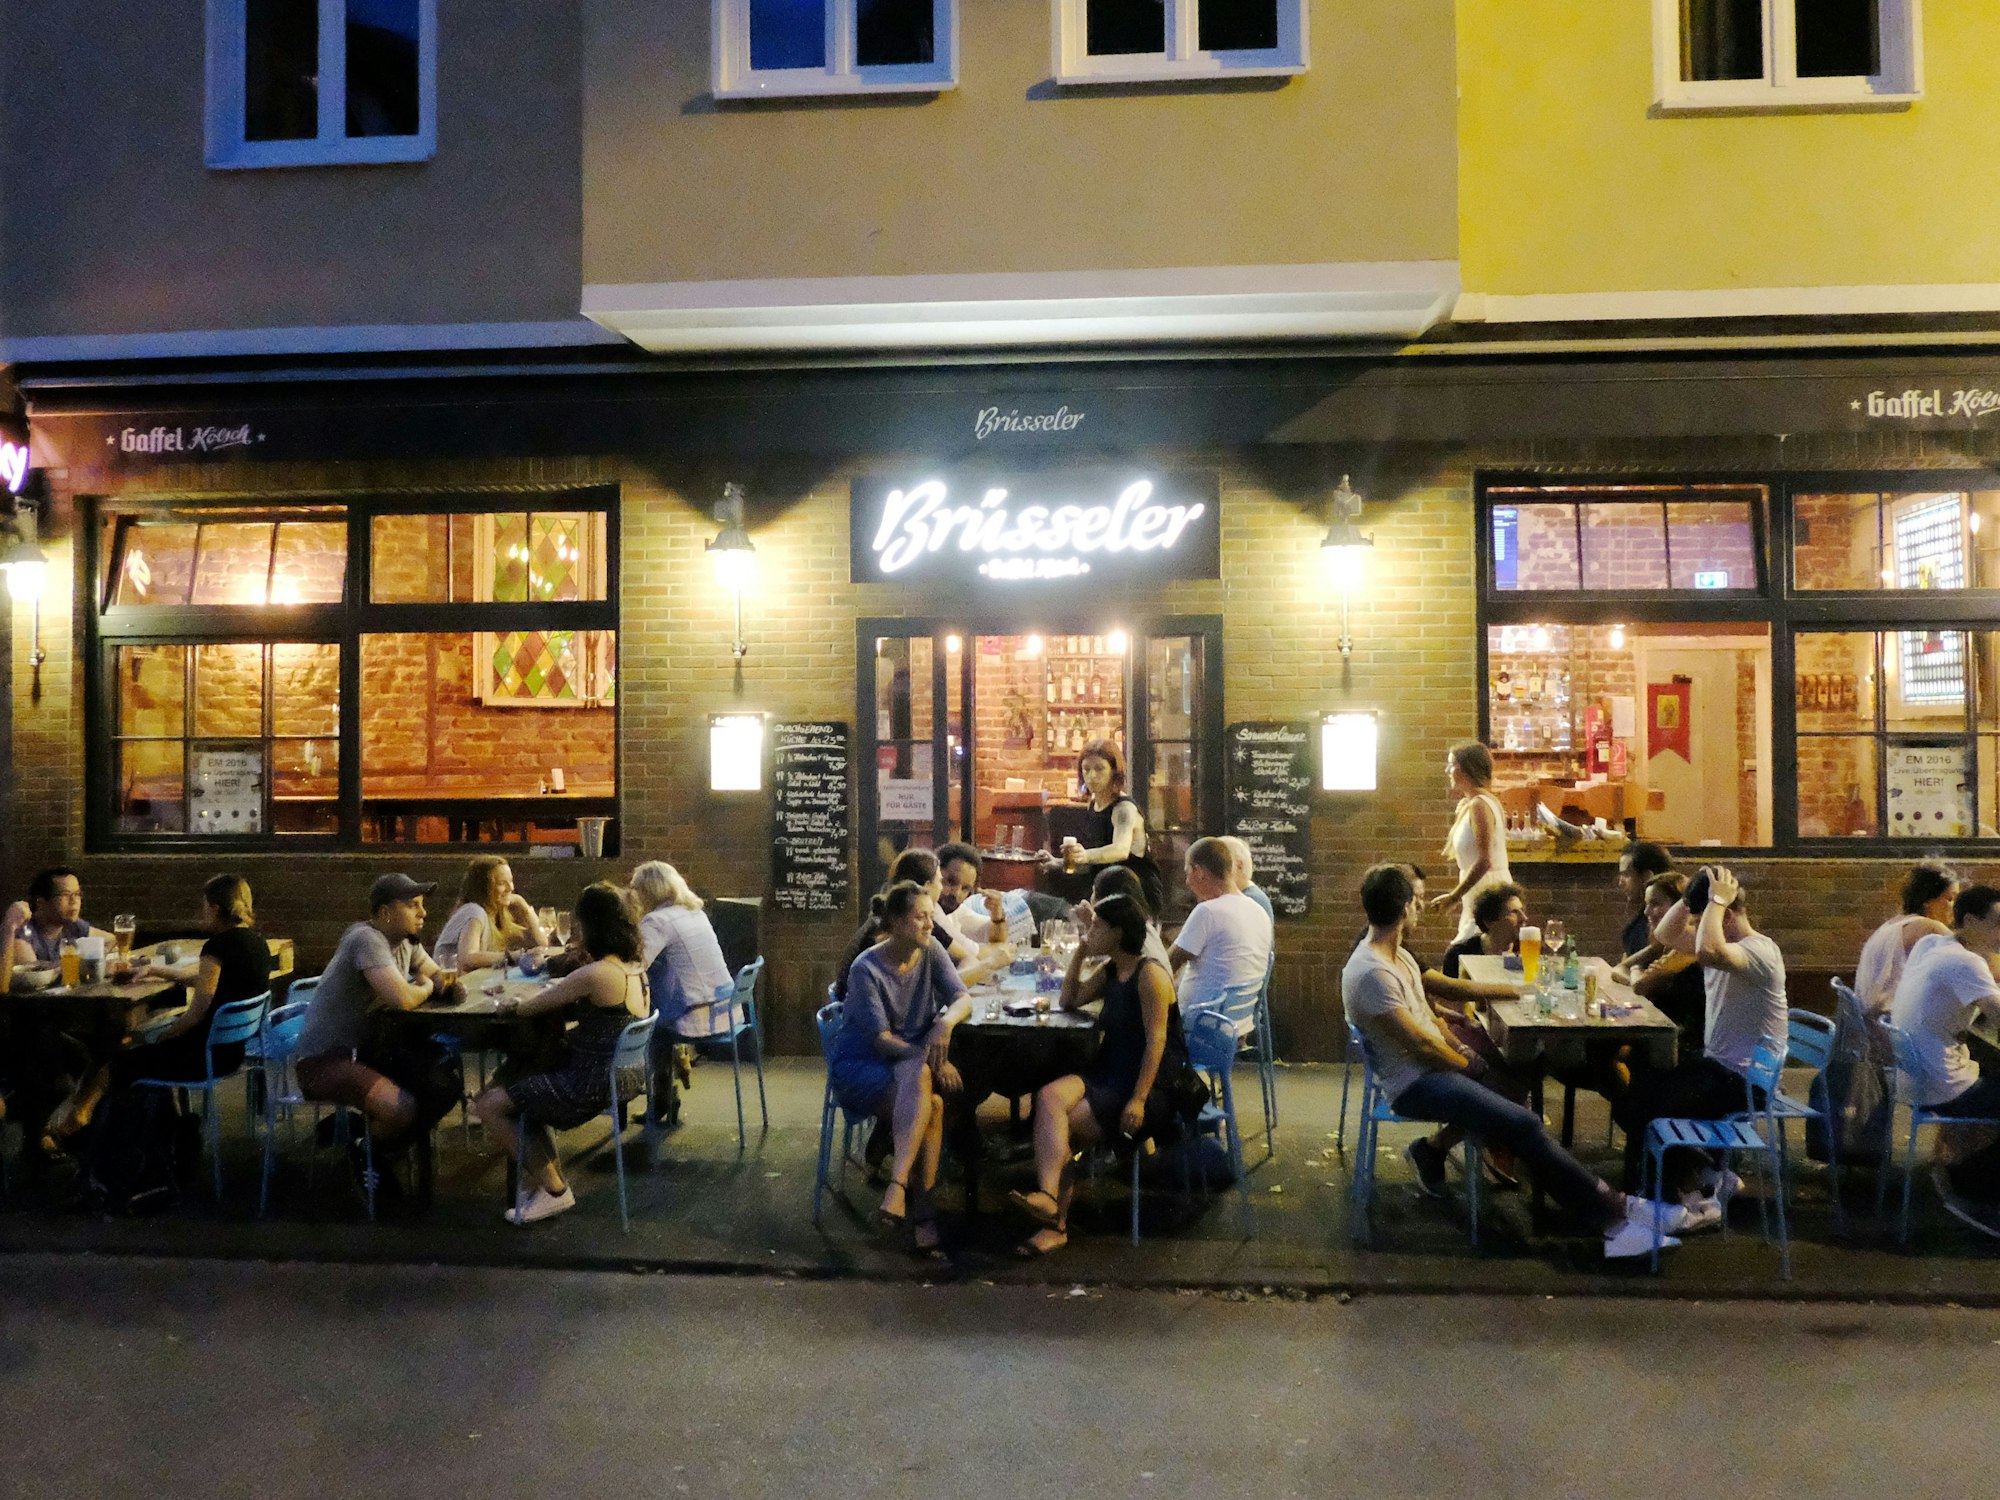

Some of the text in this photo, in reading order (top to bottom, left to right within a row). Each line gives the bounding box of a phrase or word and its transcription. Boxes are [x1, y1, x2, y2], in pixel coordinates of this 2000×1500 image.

[1868, 389, 1944, 418] Gaffel
[974, 405, 1085, 440] Brüsseler
[120, 424, 252, 453] Gaffel Kölsch
[872, 480, 1205, 573] Brüsseler
[1905, 755, 1952, 765] EM 2016
[1914, 777, 1944, 787] HIER!
